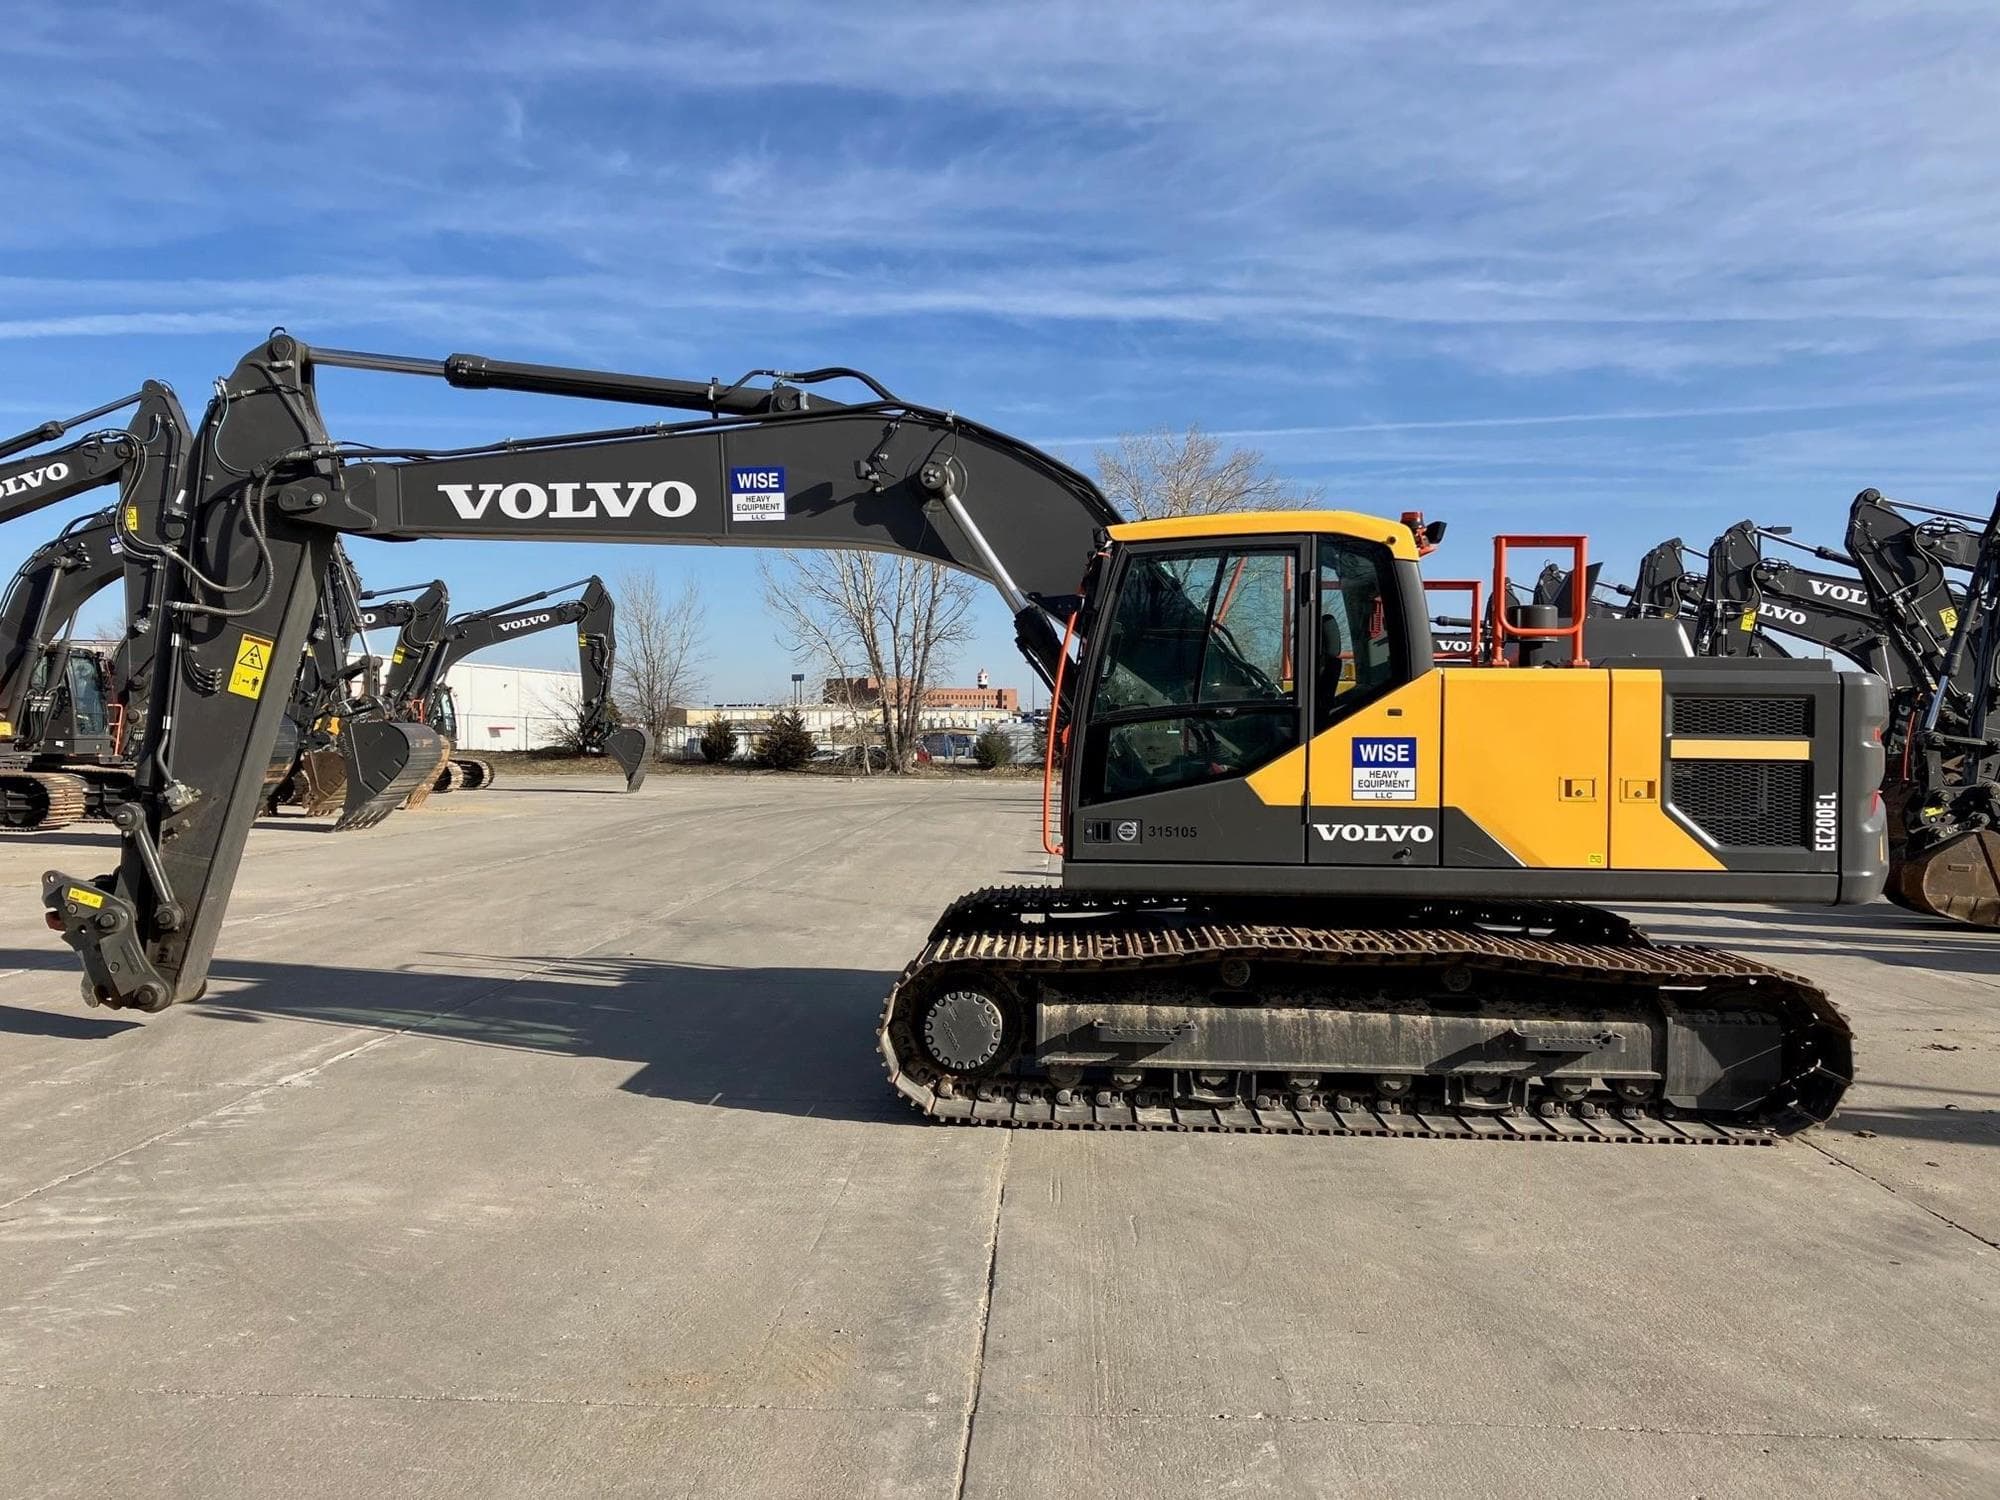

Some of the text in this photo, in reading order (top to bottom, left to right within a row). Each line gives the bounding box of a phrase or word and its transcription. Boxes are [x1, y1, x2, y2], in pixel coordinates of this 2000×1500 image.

[0, 462, 69, 499] LVO
[736, 472, 780, 489] WISE
[437, 481, 697, 519] VOLVO
[736, 503, 780, 511] EQUIPMENT
[1808, 579, 1868, 605] VOL
[498, 613, 550, 632] VOLVO
[1758, 601, 1807, 625] LVO
[1359, 743, 1410, 762] WISE
[1358, 779, 1410, 789] EQUIPMENT
[1369, 770, 1399, 779] HEAVY
[1375, 791, 1393, 799] LLC
[1148, 825, 1197, 838] 315105
[1312, 823, 1434, 843] VOLVO
